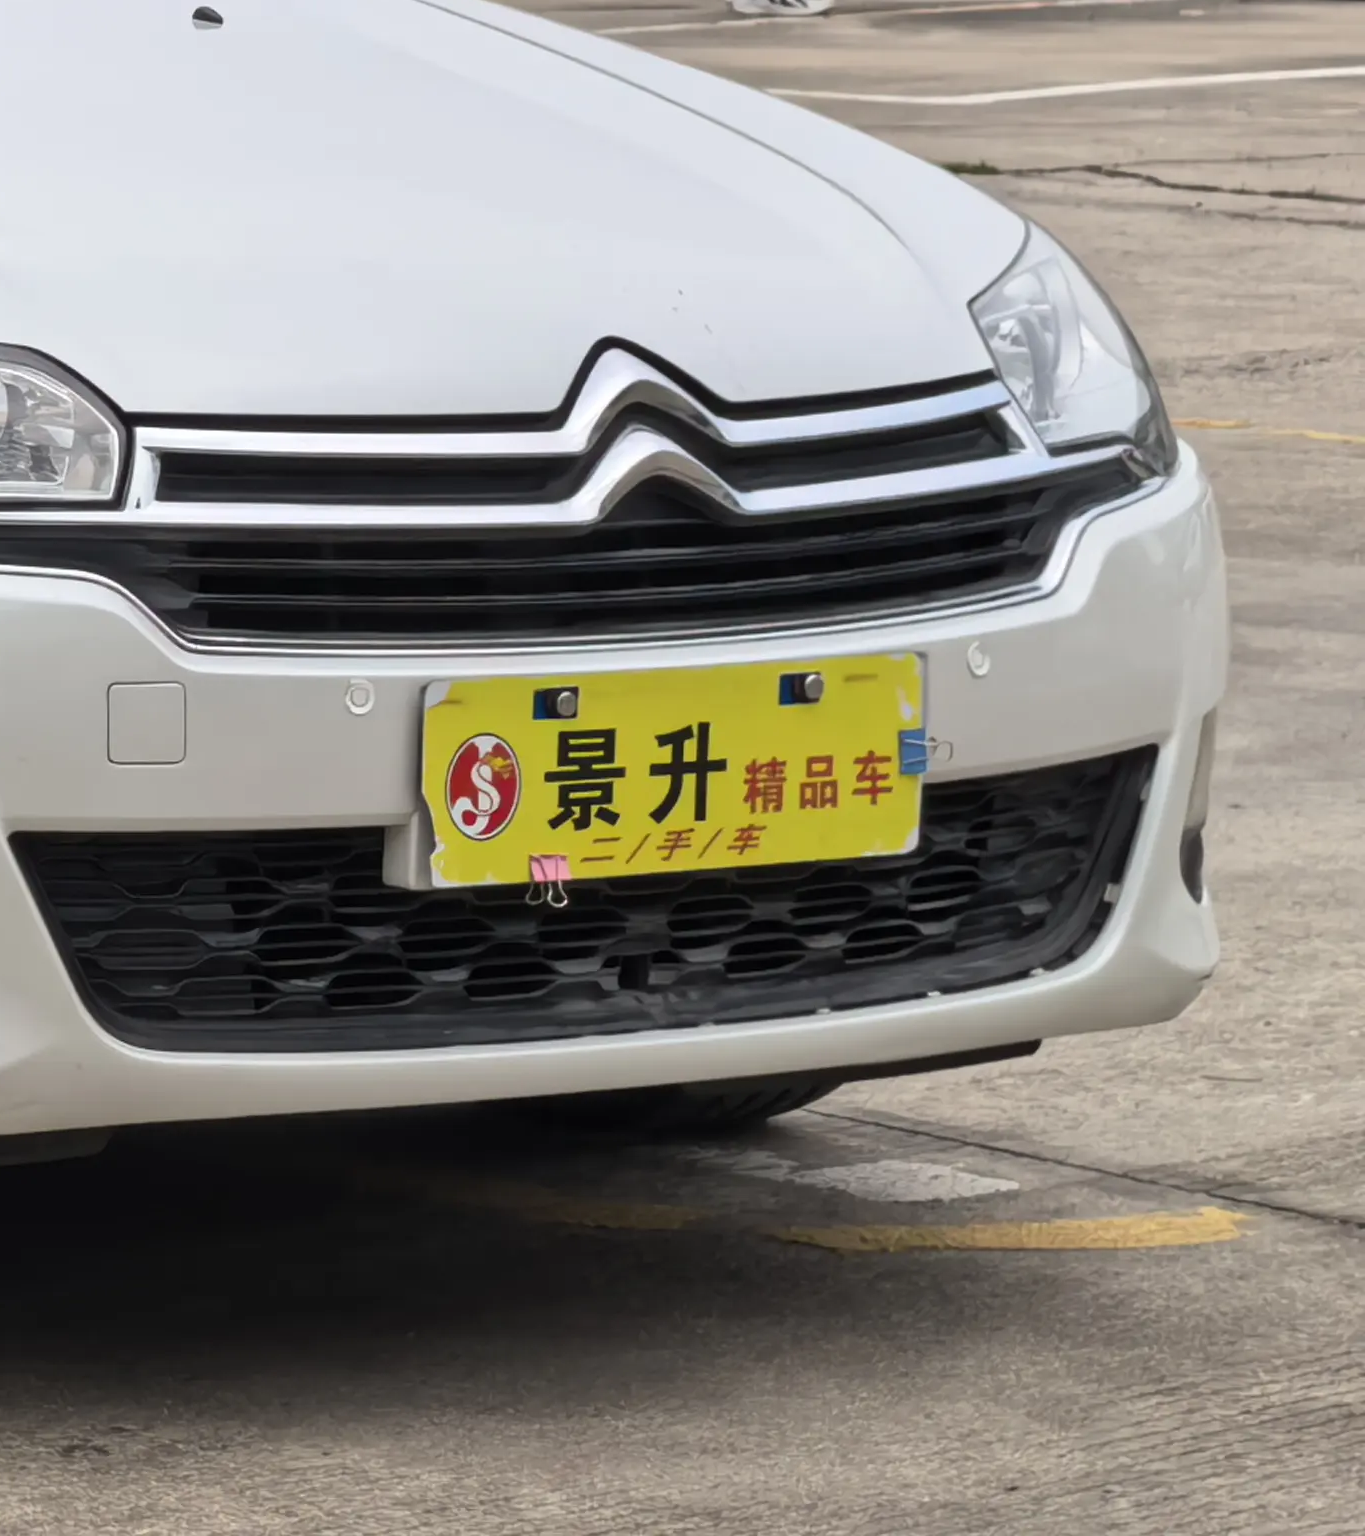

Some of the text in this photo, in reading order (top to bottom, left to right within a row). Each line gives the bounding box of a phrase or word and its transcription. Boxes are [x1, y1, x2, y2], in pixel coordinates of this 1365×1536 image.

[544, 721, 893, 831] 景升 精品车
